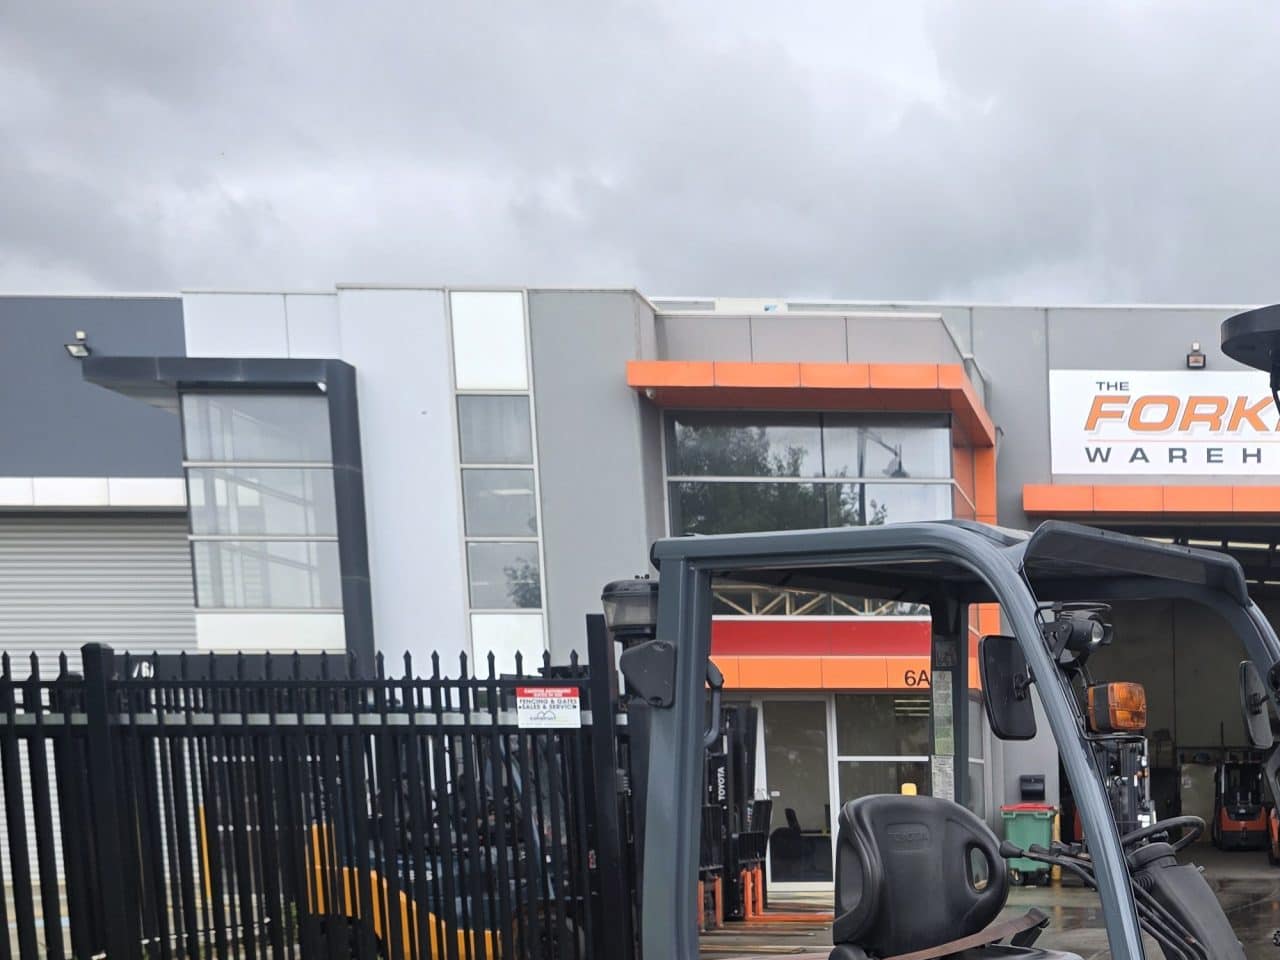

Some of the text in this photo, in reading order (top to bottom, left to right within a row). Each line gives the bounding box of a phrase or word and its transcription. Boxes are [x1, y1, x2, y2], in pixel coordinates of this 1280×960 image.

[1095, 381, 1130, 391] THE
[904, 669, 931, 687] 6A
[717, 766, 727, 801] TOYOTA
